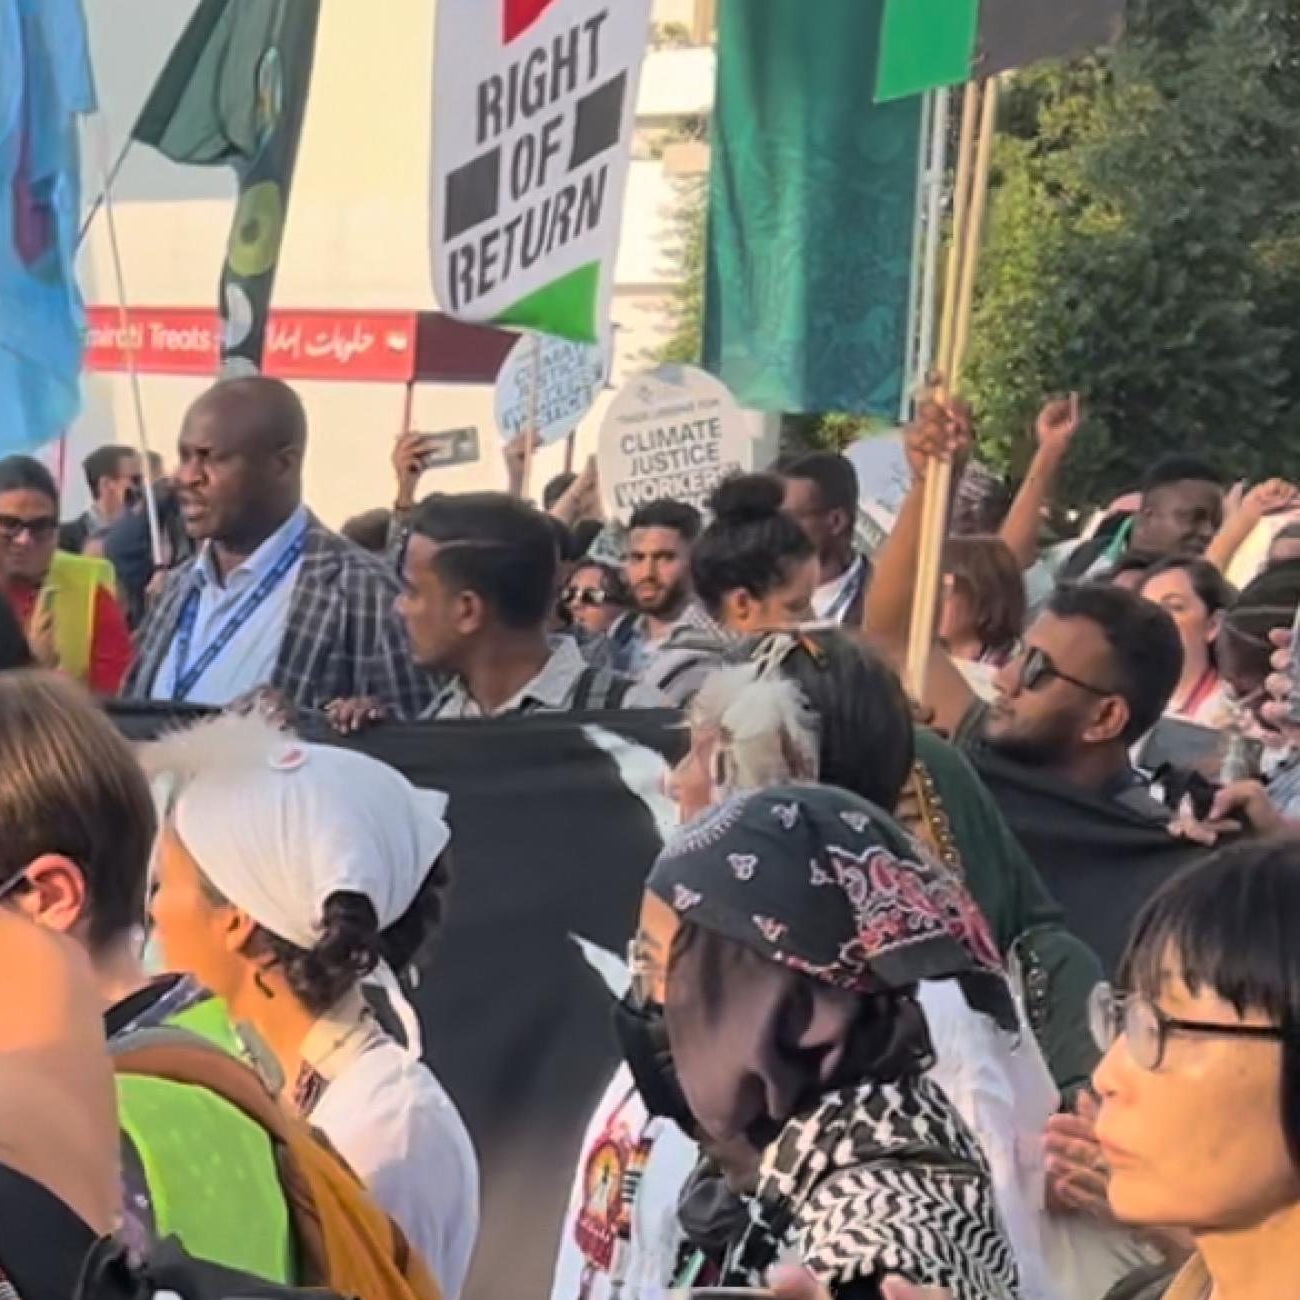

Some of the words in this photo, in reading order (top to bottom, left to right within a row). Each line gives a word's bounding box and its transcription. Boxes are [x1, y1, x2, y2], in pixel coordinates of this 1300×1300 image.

[477, 9, 608, 145] RIGHT
[511, 113, 564, 201] OF
[449, 163, 607, 312] RETURN
[620, 418, 721, 455] CLIMATE
[631, 442, 718, 477] JUSTICE
